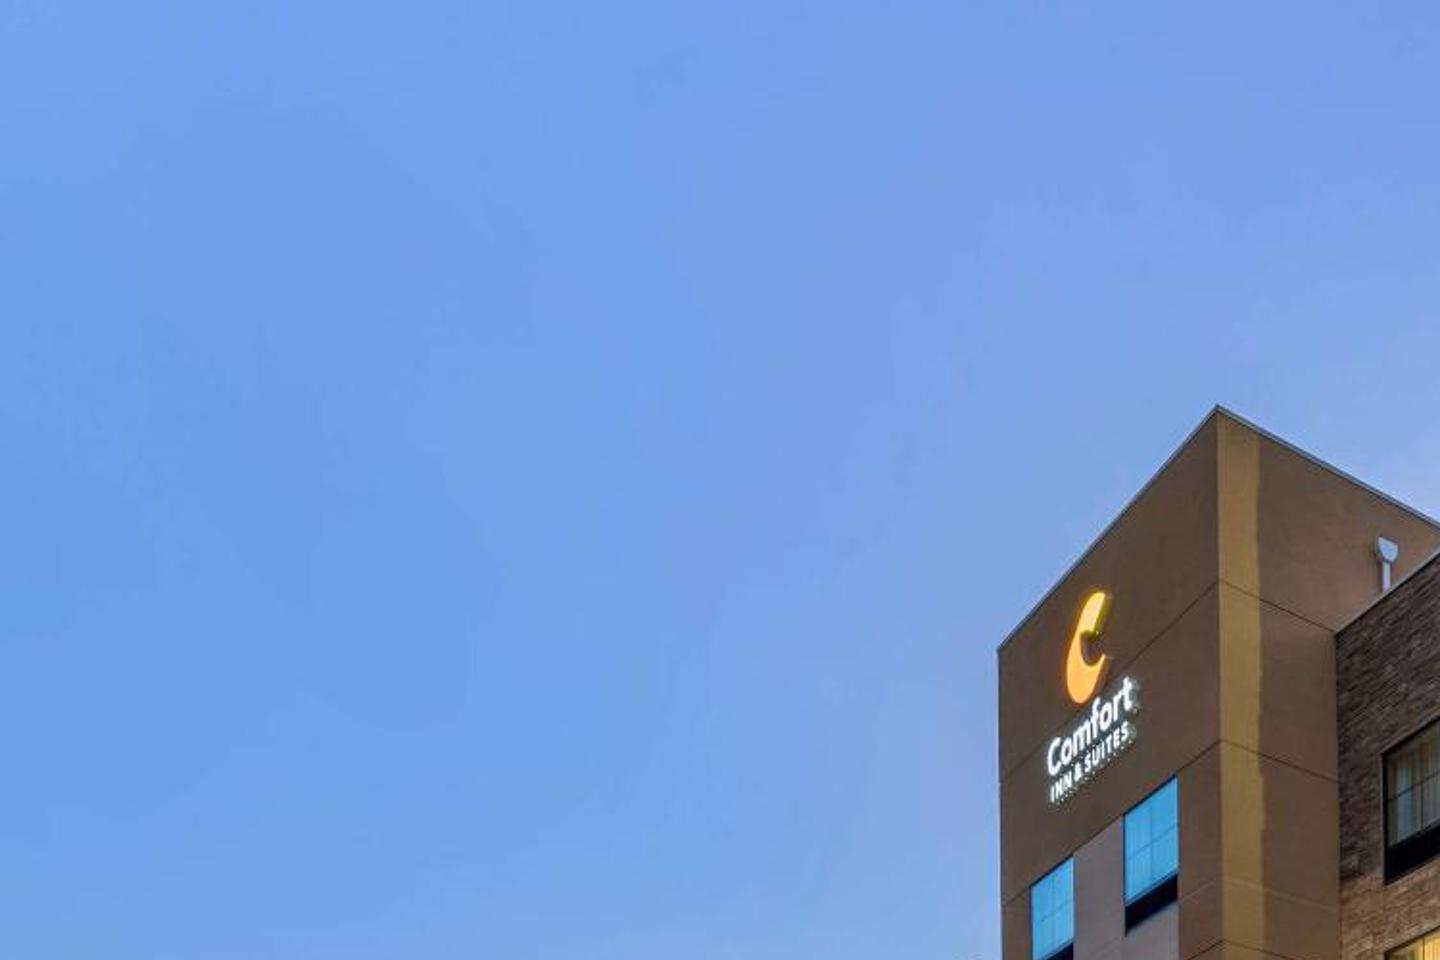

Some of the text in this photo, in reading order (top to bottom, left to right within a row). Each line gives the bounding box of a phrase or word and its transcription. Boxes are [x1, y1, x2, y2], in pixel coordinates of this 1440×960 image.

[1046, 676, 1133, 777] Comfort
[1049, 720, 1130, 804] INN & SUITES
